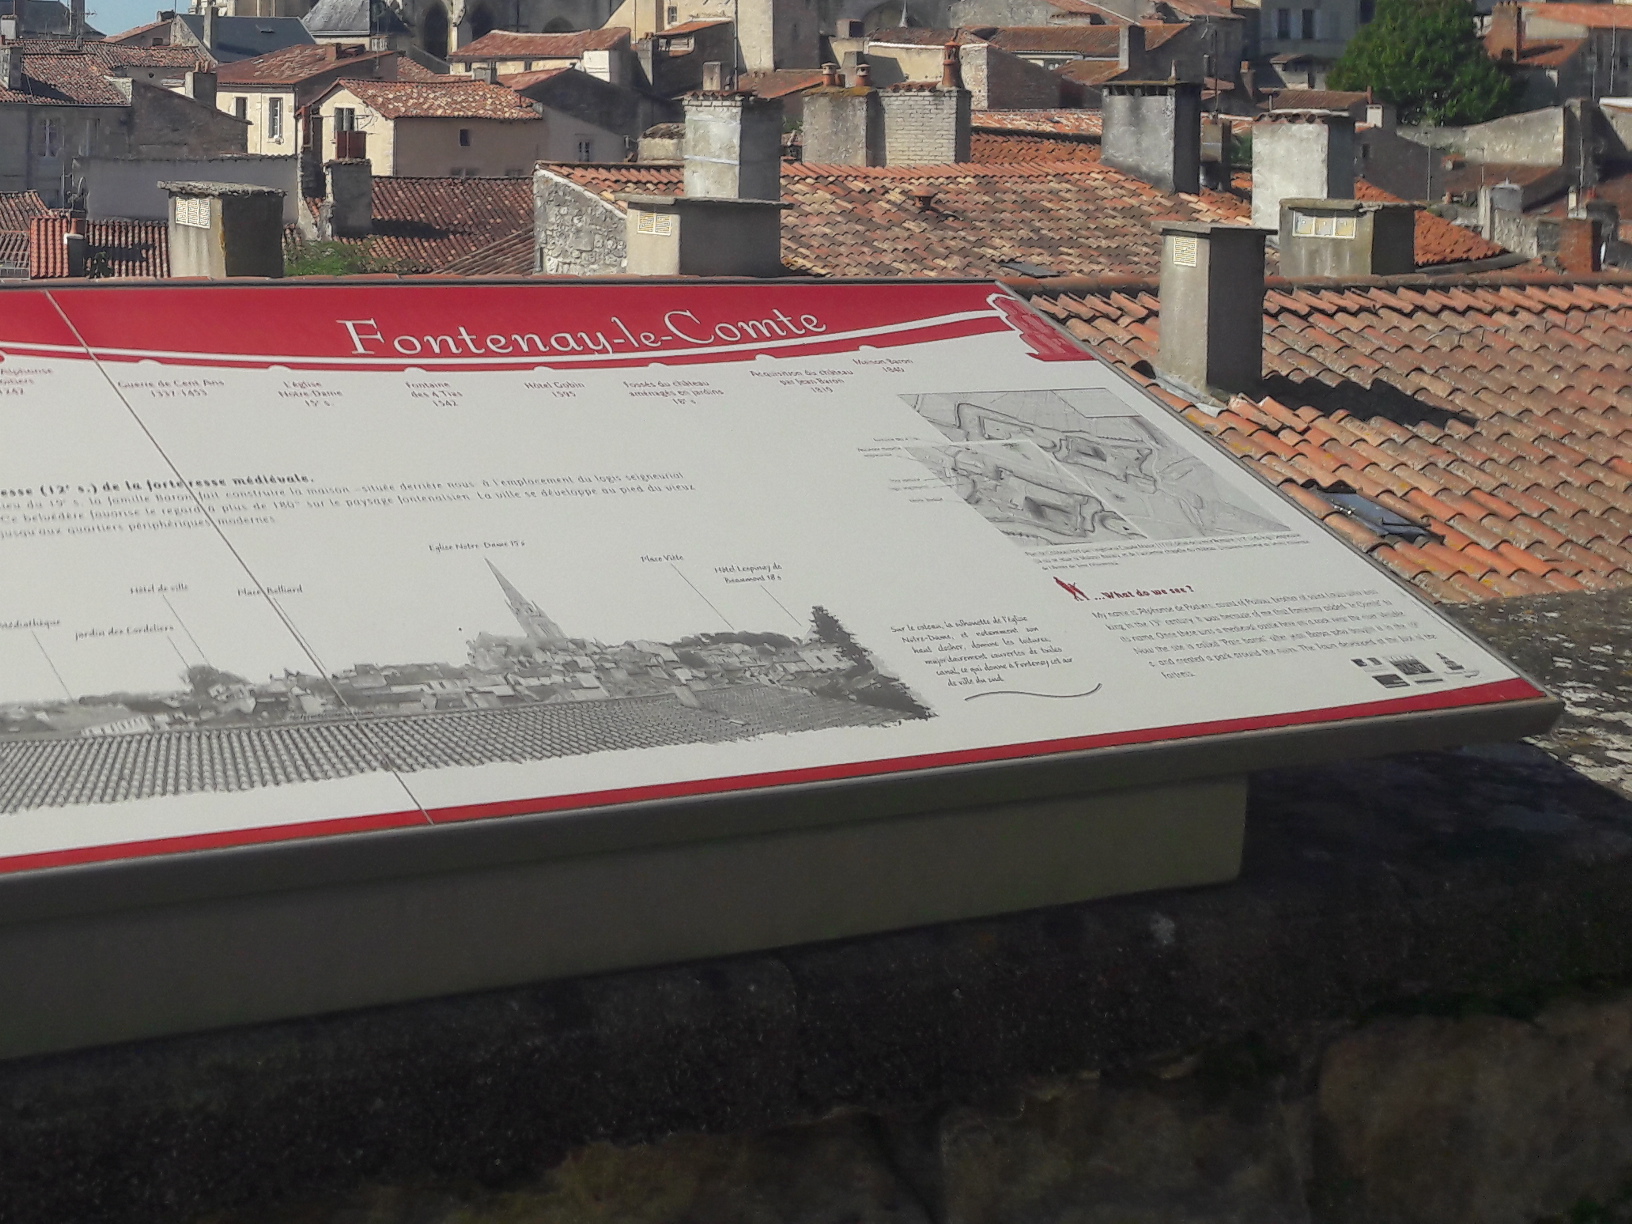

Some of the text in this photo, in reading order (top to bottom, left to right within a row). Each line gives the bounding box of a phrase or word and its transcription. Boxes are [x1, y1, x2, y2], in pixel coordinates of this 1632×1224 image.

[336, 309, 827, 355] Fontenay-le-Comte
[993, 616, 1002, 624] de
[960, 631, 969, 639] et
[912, 645, 933, 654] haut
[1003, 637, 1015, 645] les
[1029, 647, 1039, 655] de
[947, 678, 957, 687] de
[975, 675, 987, 684] du
